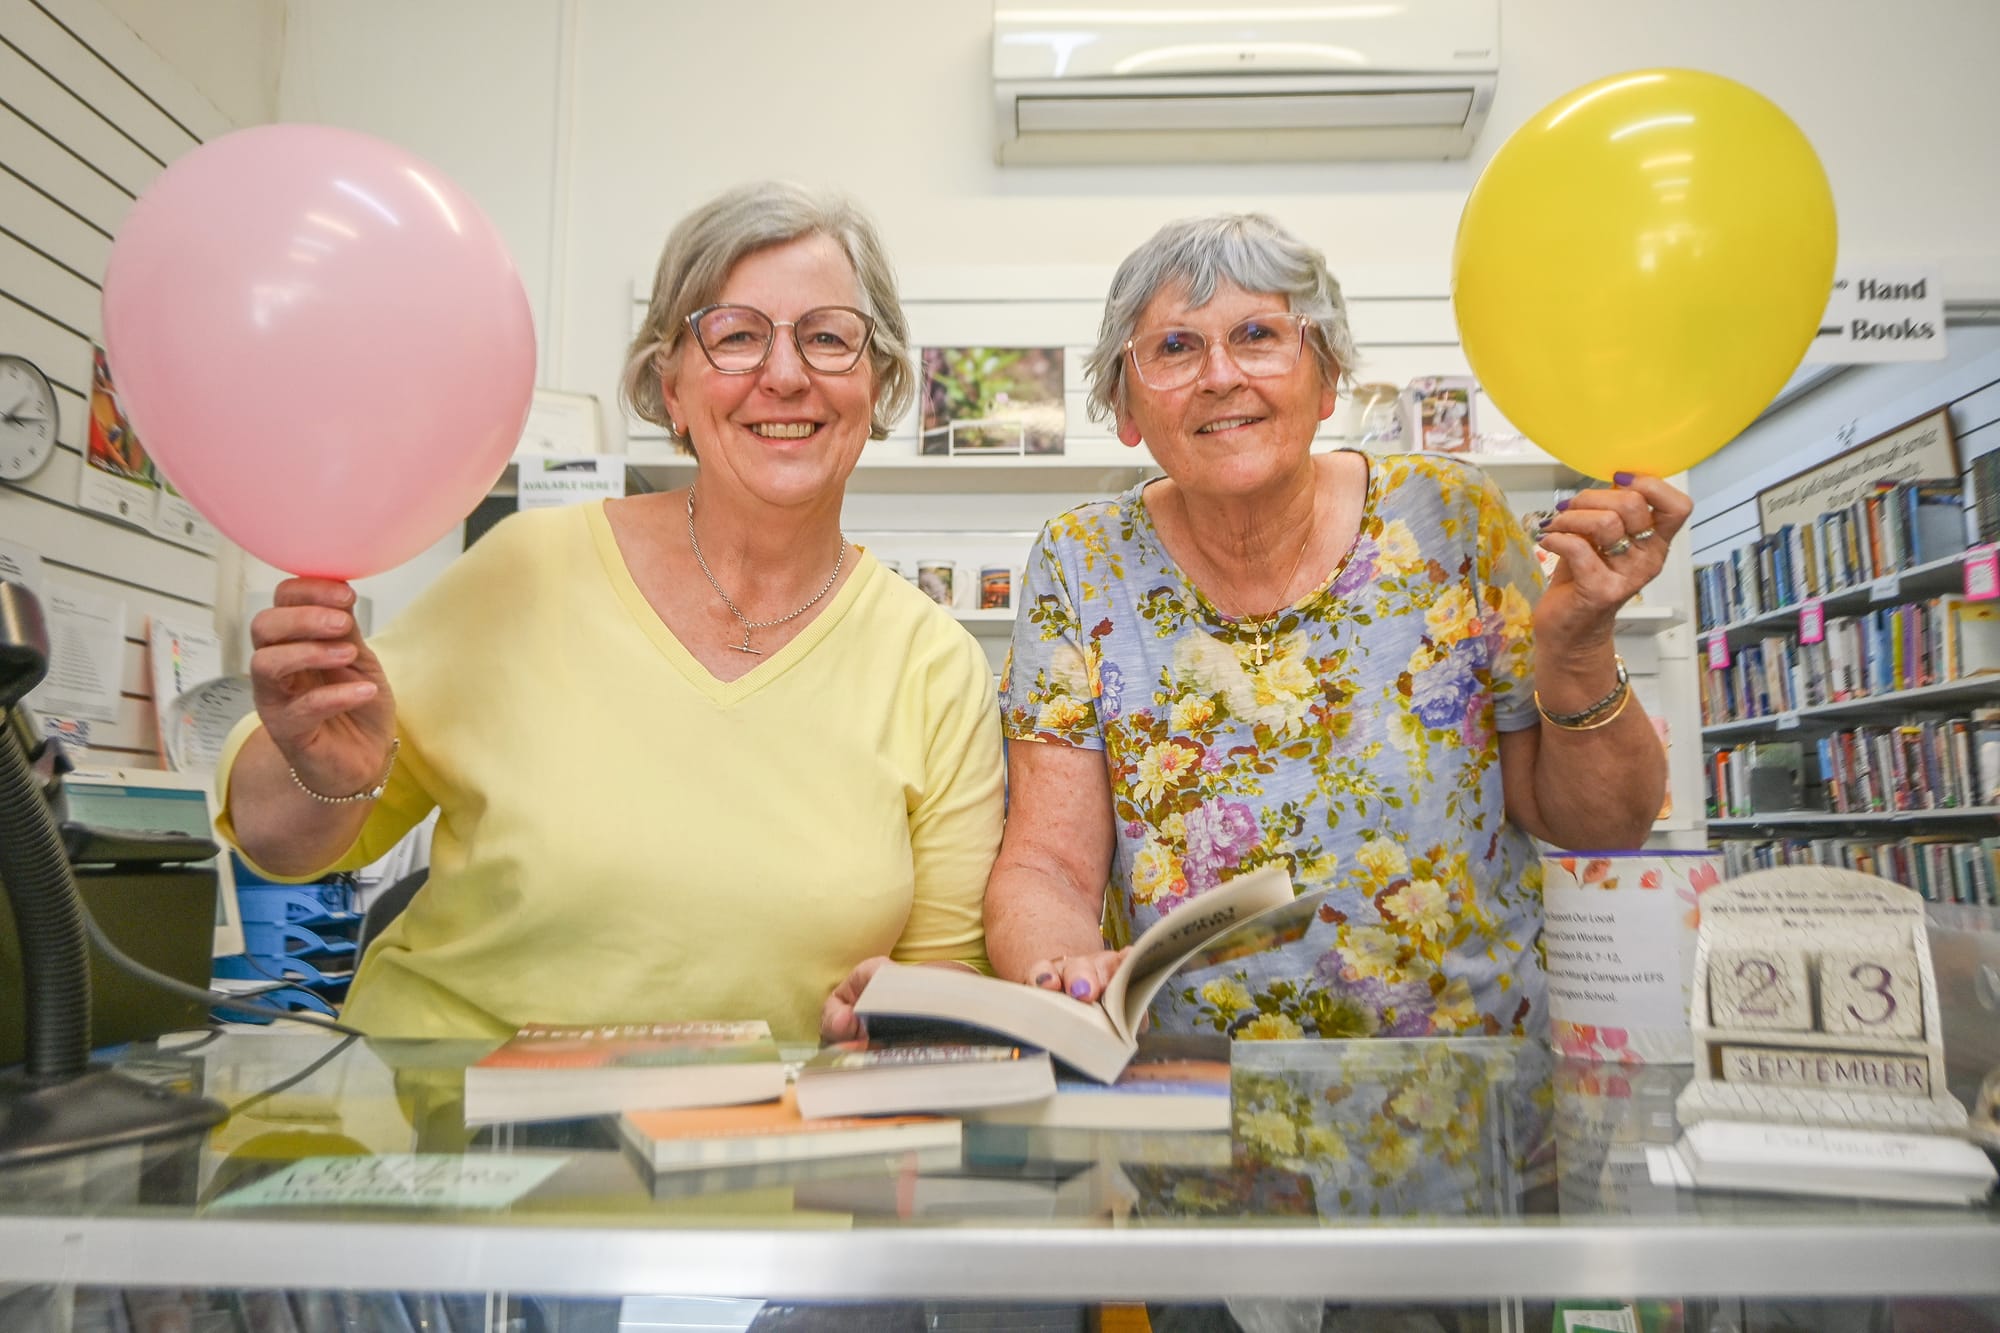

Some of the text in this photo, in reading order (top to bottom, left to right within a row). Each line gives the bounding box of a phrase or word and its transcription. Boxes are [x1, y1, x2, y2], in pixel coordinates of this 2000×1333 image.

[1858, 278, 1927, 300] Hand
[1852, 318, 1936, 340] Books
[523, 481, 577, 491] AVAILABLE
[1589, 912, 1615, 924] Local
[1591, 971, 1631, 985] Campus
[1735, 960, 1897, 1025] 2 3
[1736, 1055, 1923, 1089] SEPTEMBER
